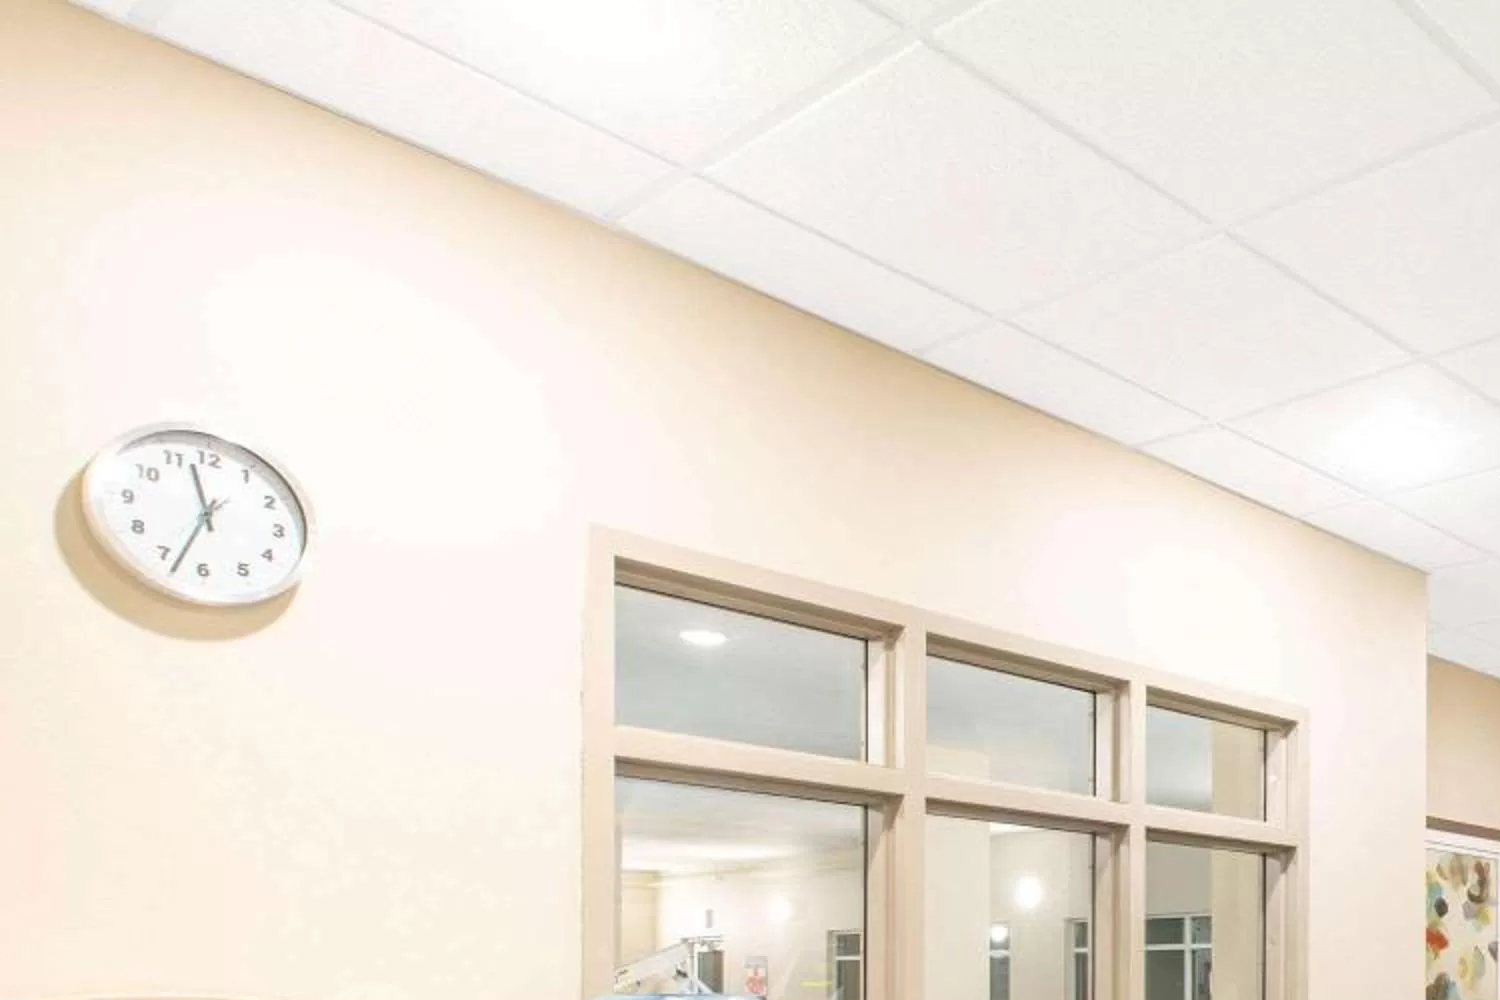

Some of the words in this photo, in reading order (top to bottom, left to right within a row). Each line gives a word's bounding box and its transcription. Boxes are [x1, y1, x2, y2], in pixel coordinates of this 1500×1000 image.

[163, 449, 184, 468] 11
[196, 450, 222, 469] 12
[135, 463, 160, 482] 10
[240, 469, 251, 484] 1
[120, 488, 136, 505] 9
[263, 495, 276, 510] 2
[131, 519, 146, 535] 8
[272, 523, 285, 539] 3
[156, 545, 171, 561] 7
[261, 548, 274, 563] 4
[196, 563, 211, 578] 6
[236, 563, 250, 578] 5
